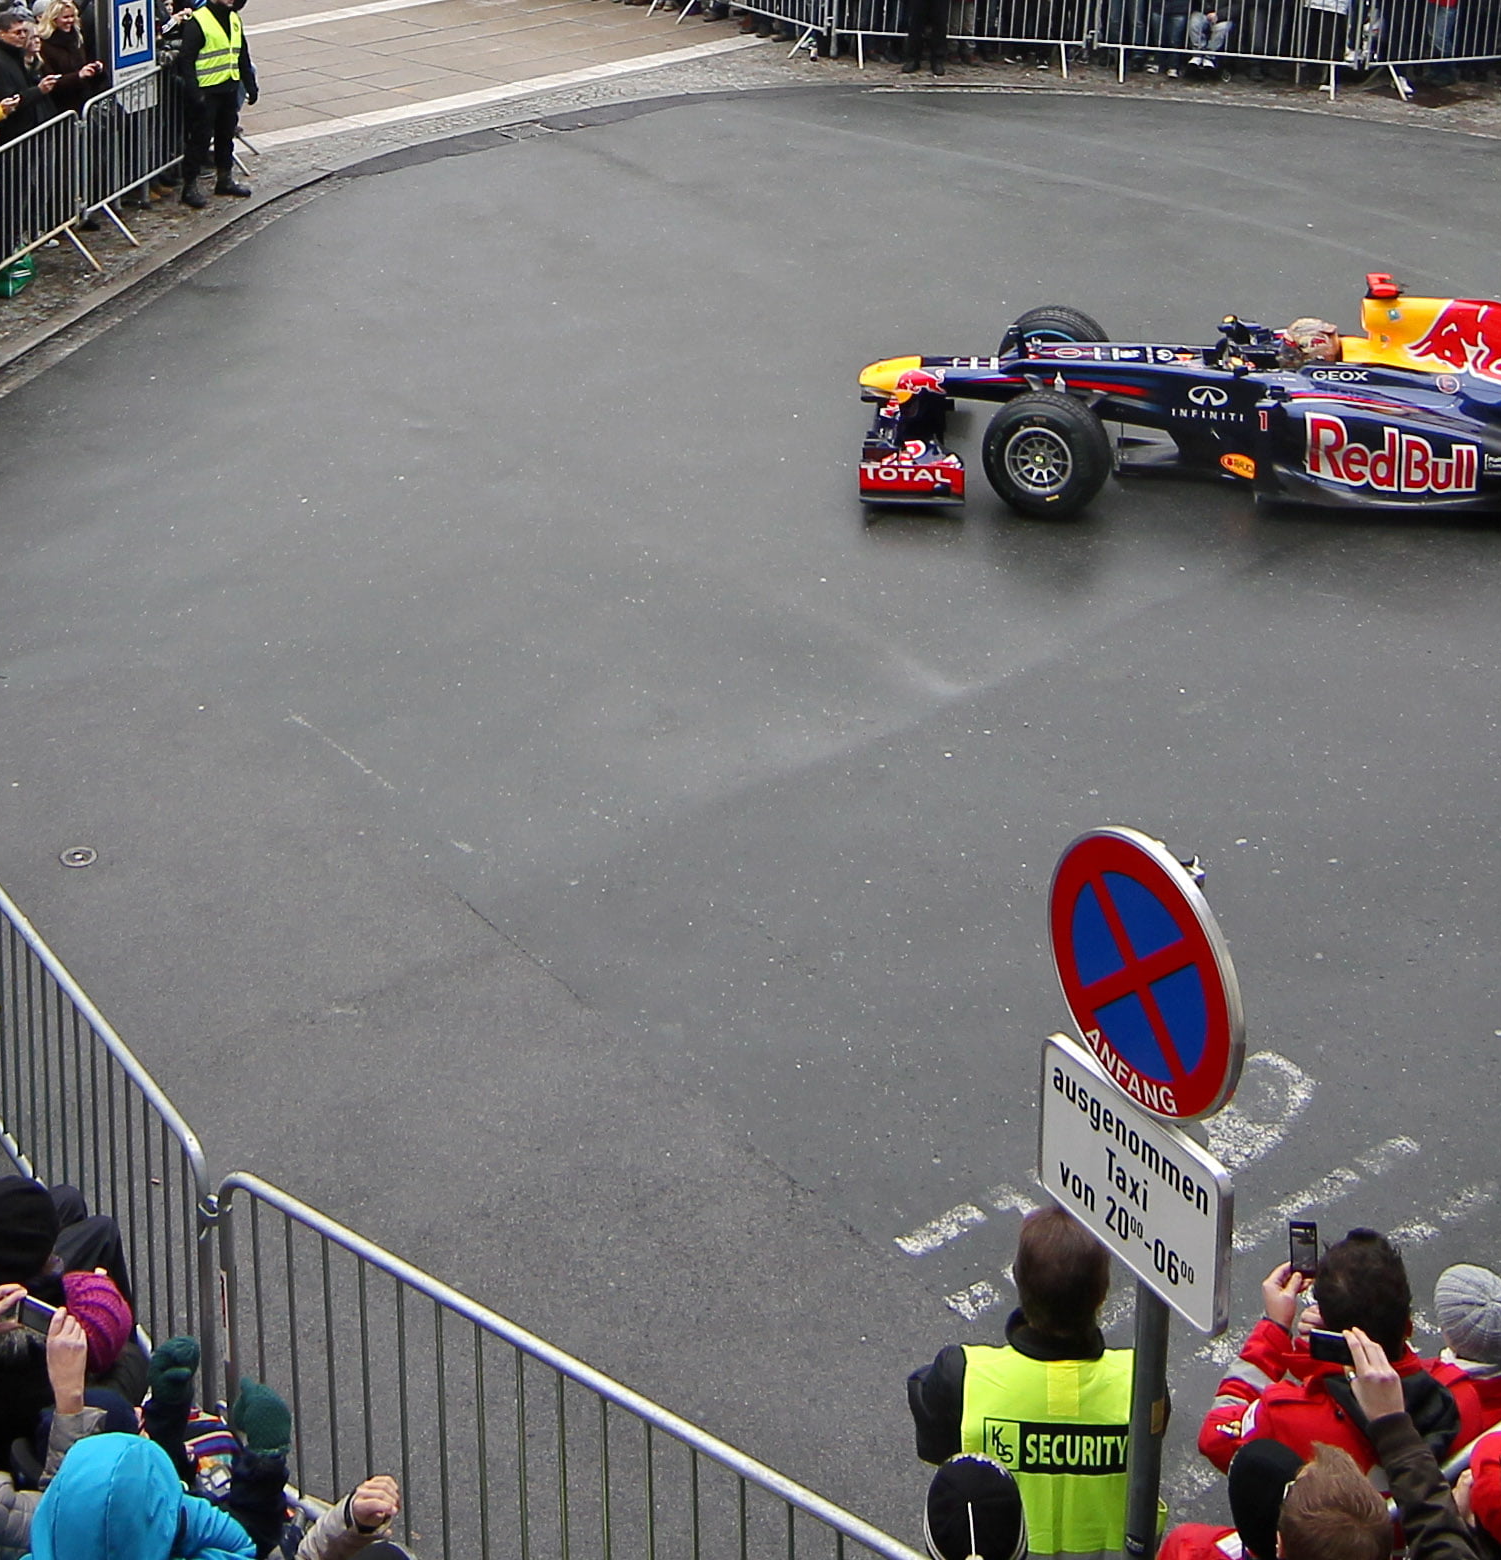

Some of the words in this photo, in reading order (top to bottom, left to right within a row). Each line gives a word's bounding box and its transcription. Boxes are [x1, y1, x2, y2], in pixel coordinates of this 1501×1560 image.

[1312, 369, 1369, 382] GEOX
[1171, 407, 1245, 423] INFINITI
[1258, 409, 1268, 432] 1
[861, 463, 952, 483] TOTAL
[1085, 1027, 1179, 1116] ANFANG
[1052, 1066, 1210, 1217] ausgenommen
[1058, 1160, 1096, 1213] von
[1104, 1146, 1149, 1213] Taxi
[1025, 1433, 1128, 1467] SECURITY
